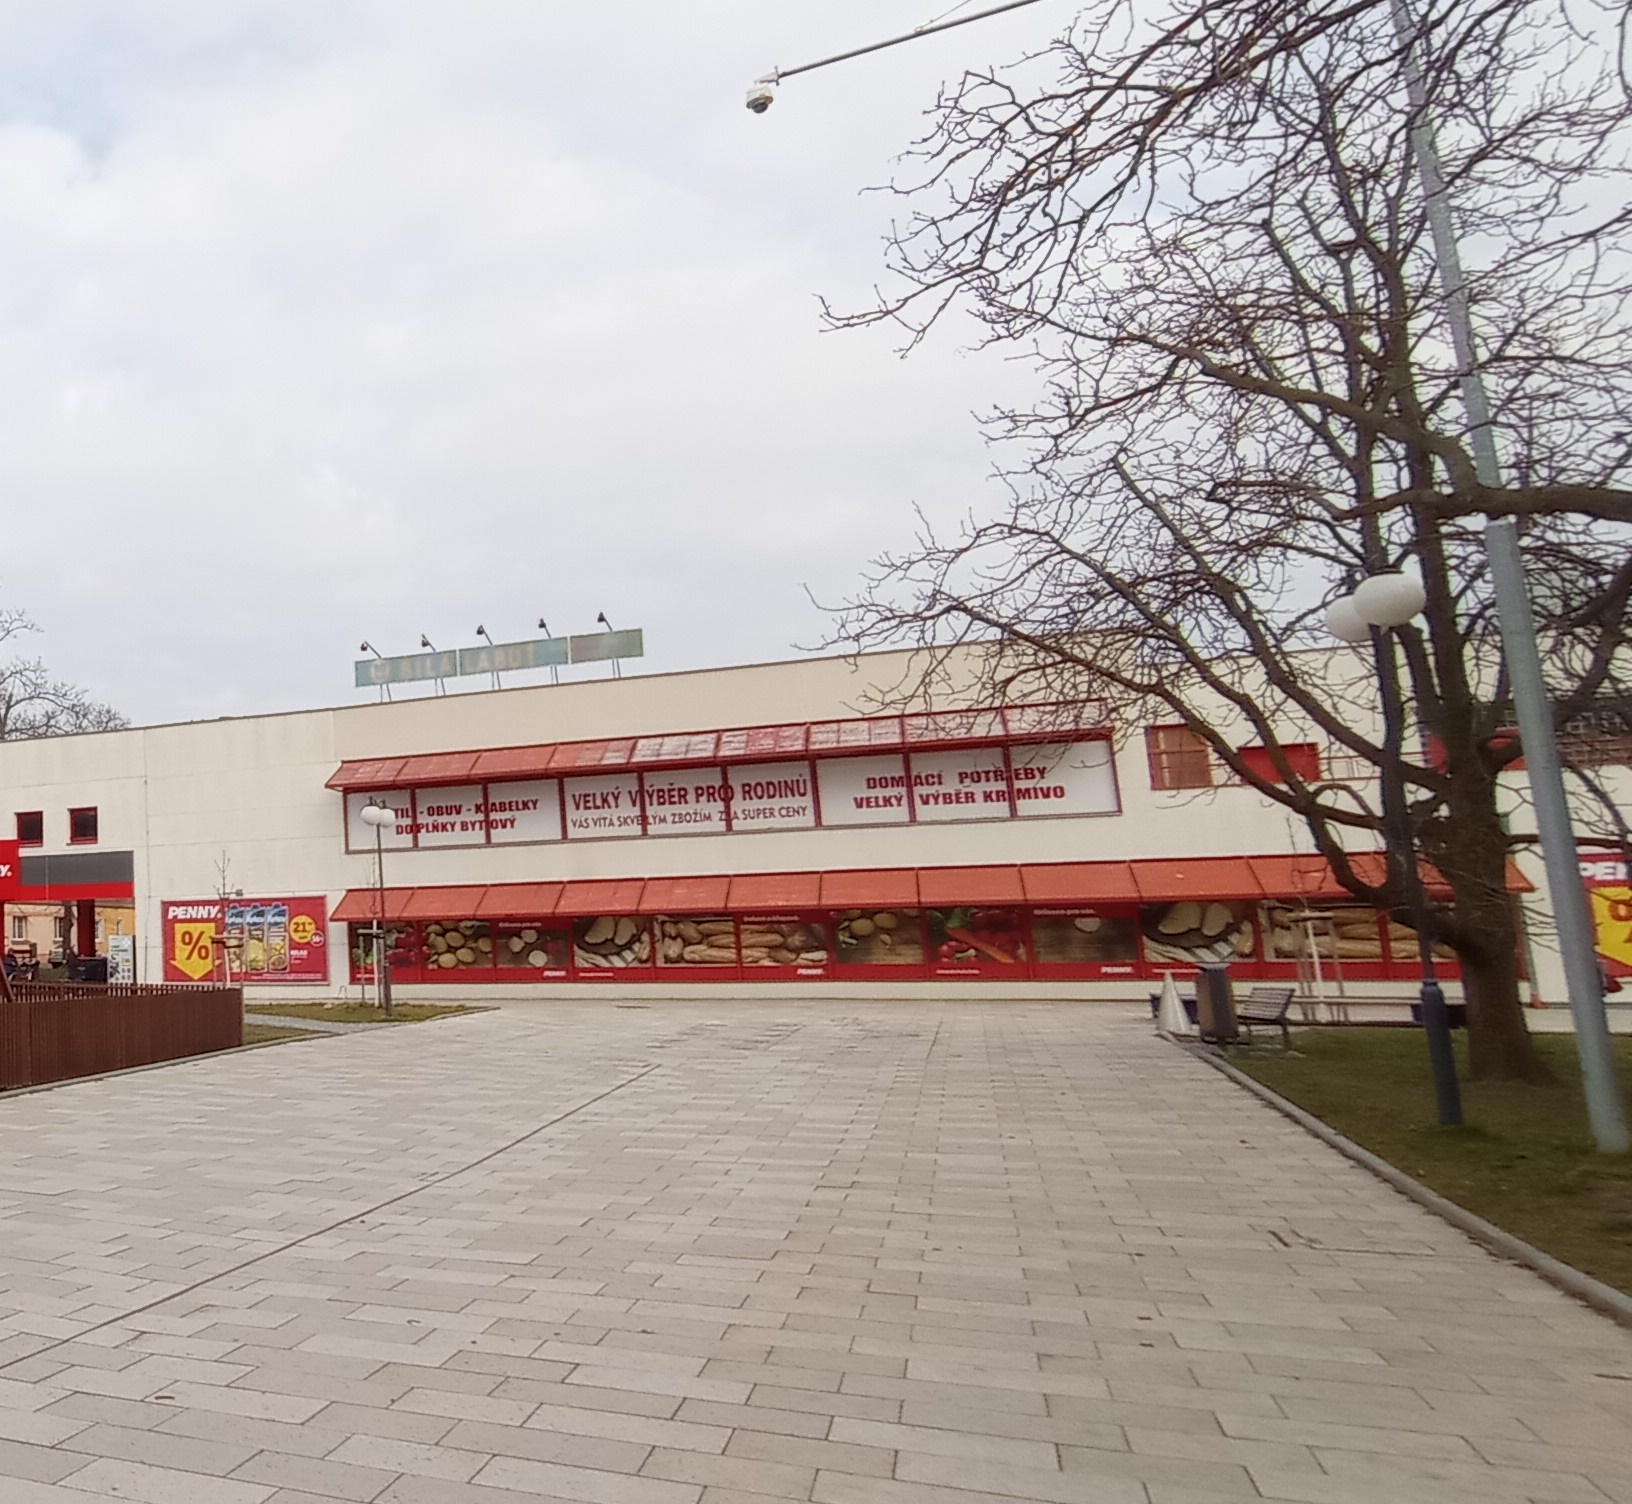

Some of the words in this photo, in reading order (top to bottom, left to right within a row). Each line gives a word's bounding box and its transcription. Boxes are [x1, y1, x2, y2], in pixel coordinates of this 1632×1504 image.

[865, 769, 943, 789] DOMÁCÍ
[958, 766, 1047, 784] POTŘEBY
[572, 787, 621, 810] VELKÝ
[628, 783, 688, 808] VÝBĚR
[695, 783, 734, 803] PRO
[742, 773, 807, 800] RODINŮ
[853, 791, 904, 809] VELKÝ
[918, 788, 976, 806] VÝBĚR
[983, 785, 1065, 803] KRMIVO
[394, 808, 413, 819] TIL
[427, 804, 462, 817] OBUV
[475, 799, 539, 814] KABELKY
[571, 814, 589, 829] VÁS
[591, 813, 615, 828] VÍTÁ
[671, 810, 712, 823] ZBOŽÍM
[742, 807, 779, 821] SUPER
[781, 806, 807, 818] CENY
[395, 819, 456, 835] DOPLŇKY
[461, 815, 516, 832] BYTOVÝ
